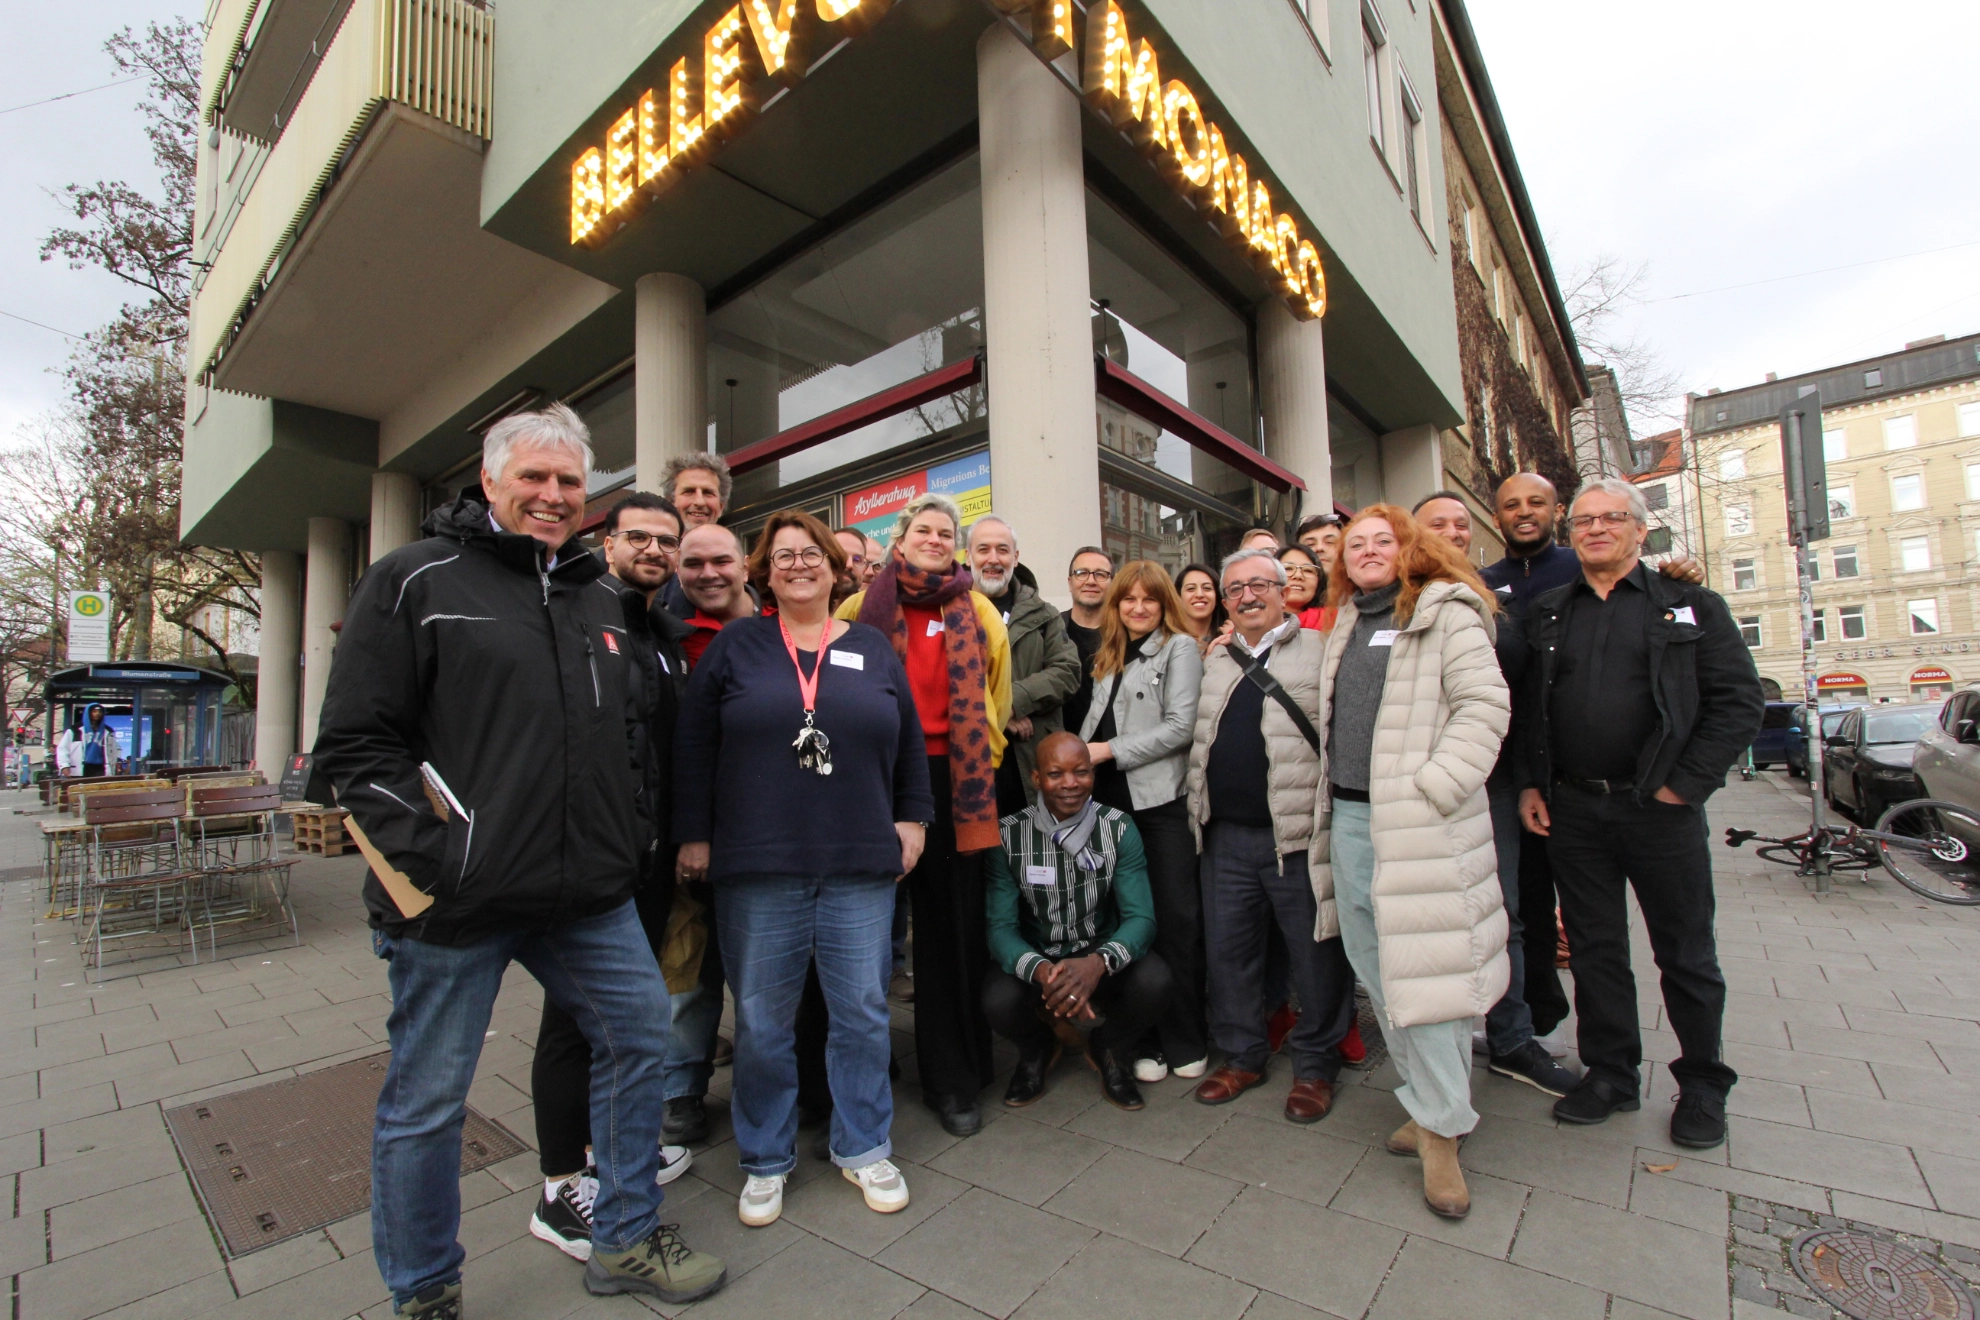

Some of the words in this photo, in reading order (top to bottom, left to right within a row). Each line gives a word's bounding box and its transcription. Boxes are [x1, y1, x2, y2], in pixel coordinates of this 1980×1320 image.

[571, 0, 862, 246] BELLEV
[1105, 0, 1326, 318] MONACO
[930, 468, 977, 491] Migrations
[854, 484, 916, 516] Asylberatung
[962, 499, 992, 513] STALTU
[82, 600, 97, 611] H
[1834, 648, 1893, 660] GEBR
